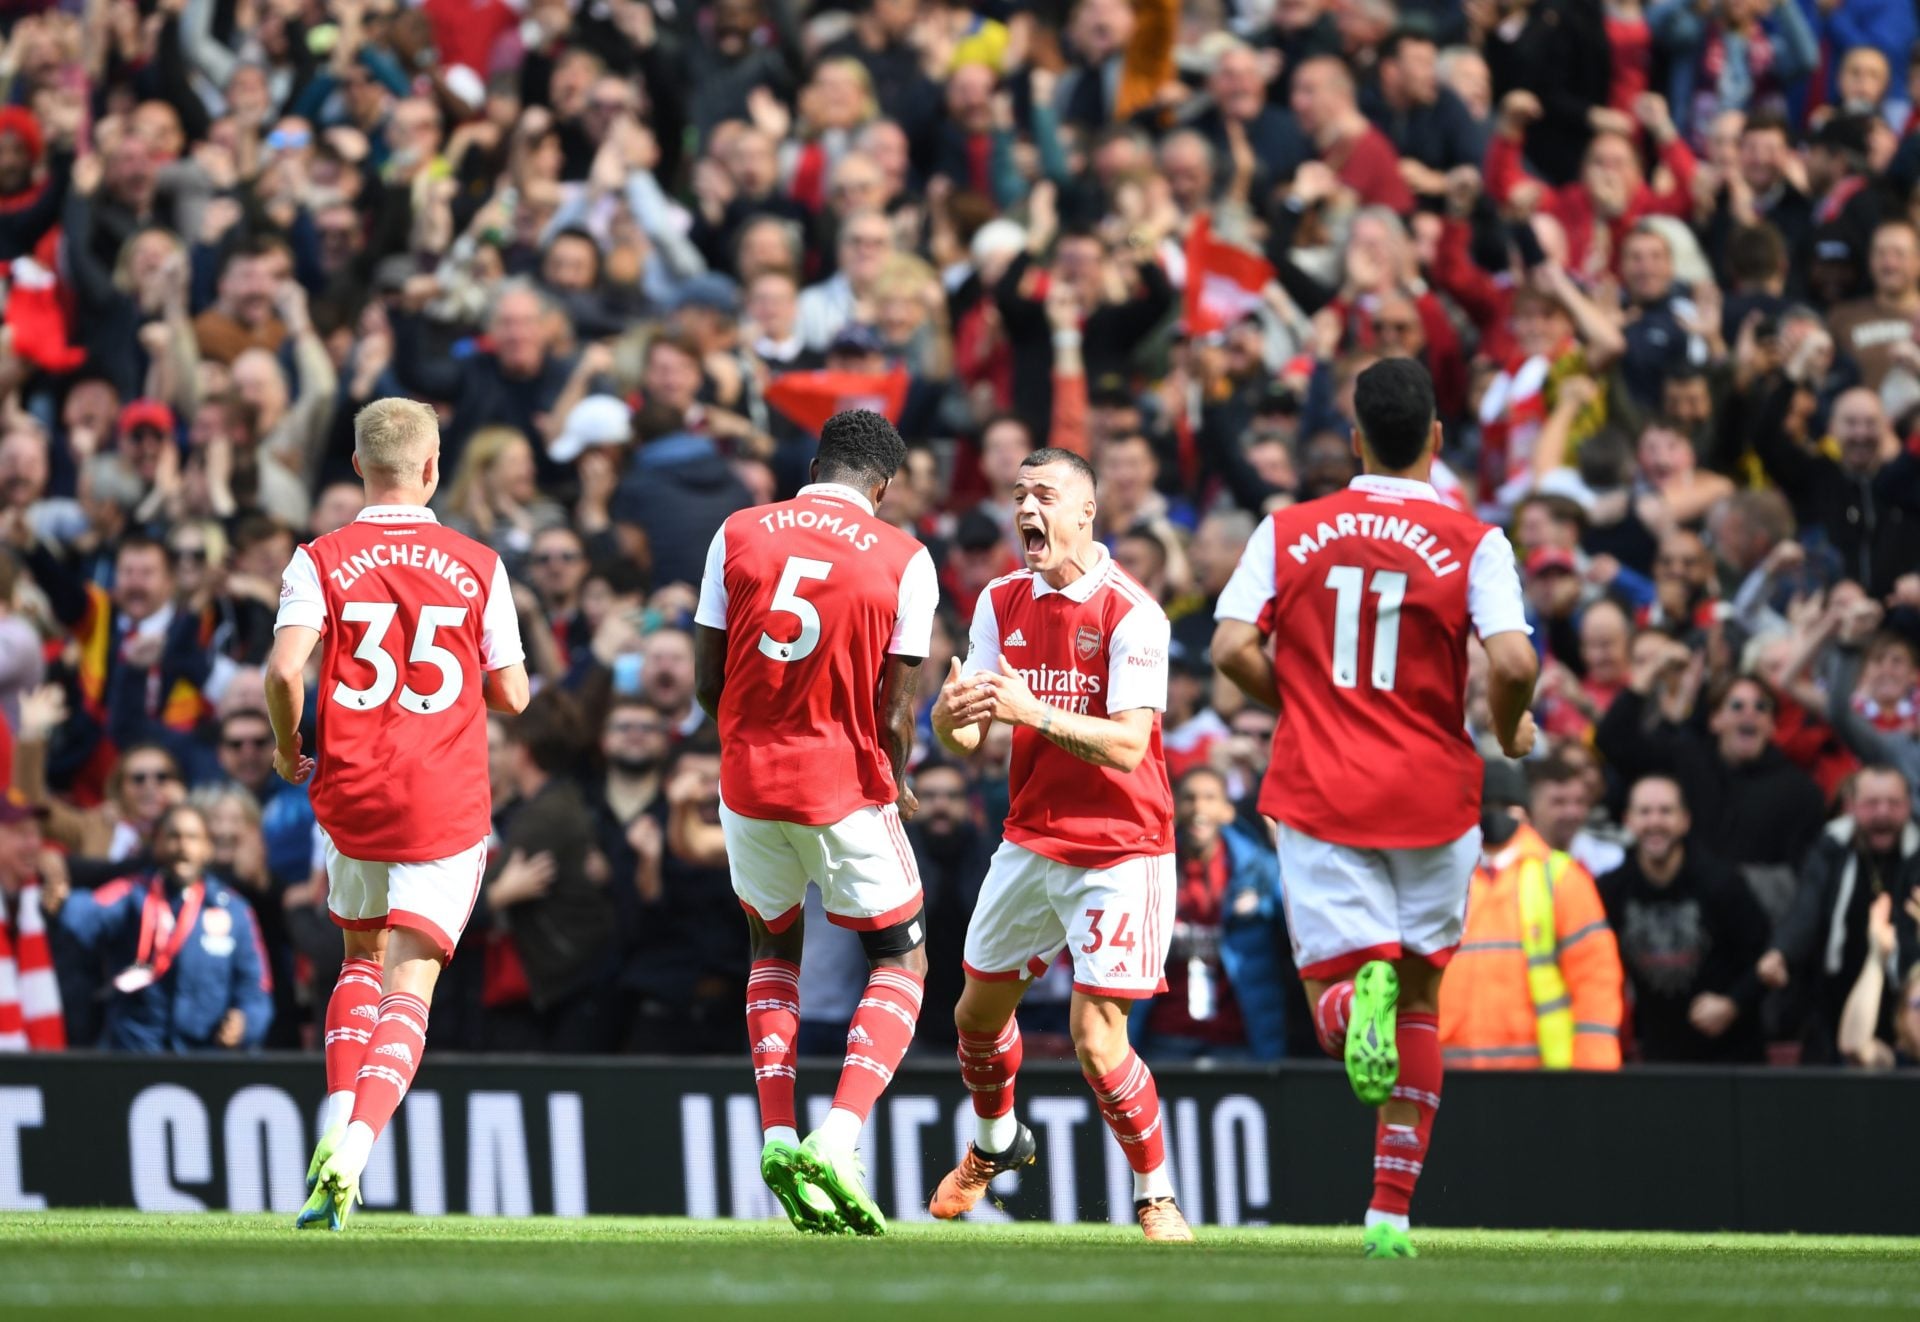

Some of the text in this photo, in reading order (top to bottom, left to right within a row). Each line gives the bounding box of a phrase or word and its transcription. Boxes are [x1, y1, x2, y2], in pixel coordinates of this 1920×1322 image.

[759, 509, 879, 551] THOMAS
[1287, 512, 1461, 578] MARTINELLI
[330, 544, 479, 598] ZINCHENKO
[757, 555, 834, 662] 5
[1324, 564, 1408, 692] 11
[332, 601, 468, 715] 35
[1003, 639, 1028, 647] adidas
[1017, 663, 1101, 693] mirates
[1080, 908, 1137, 956] 34
[128, 1082, 588, 1217] SOIAL
